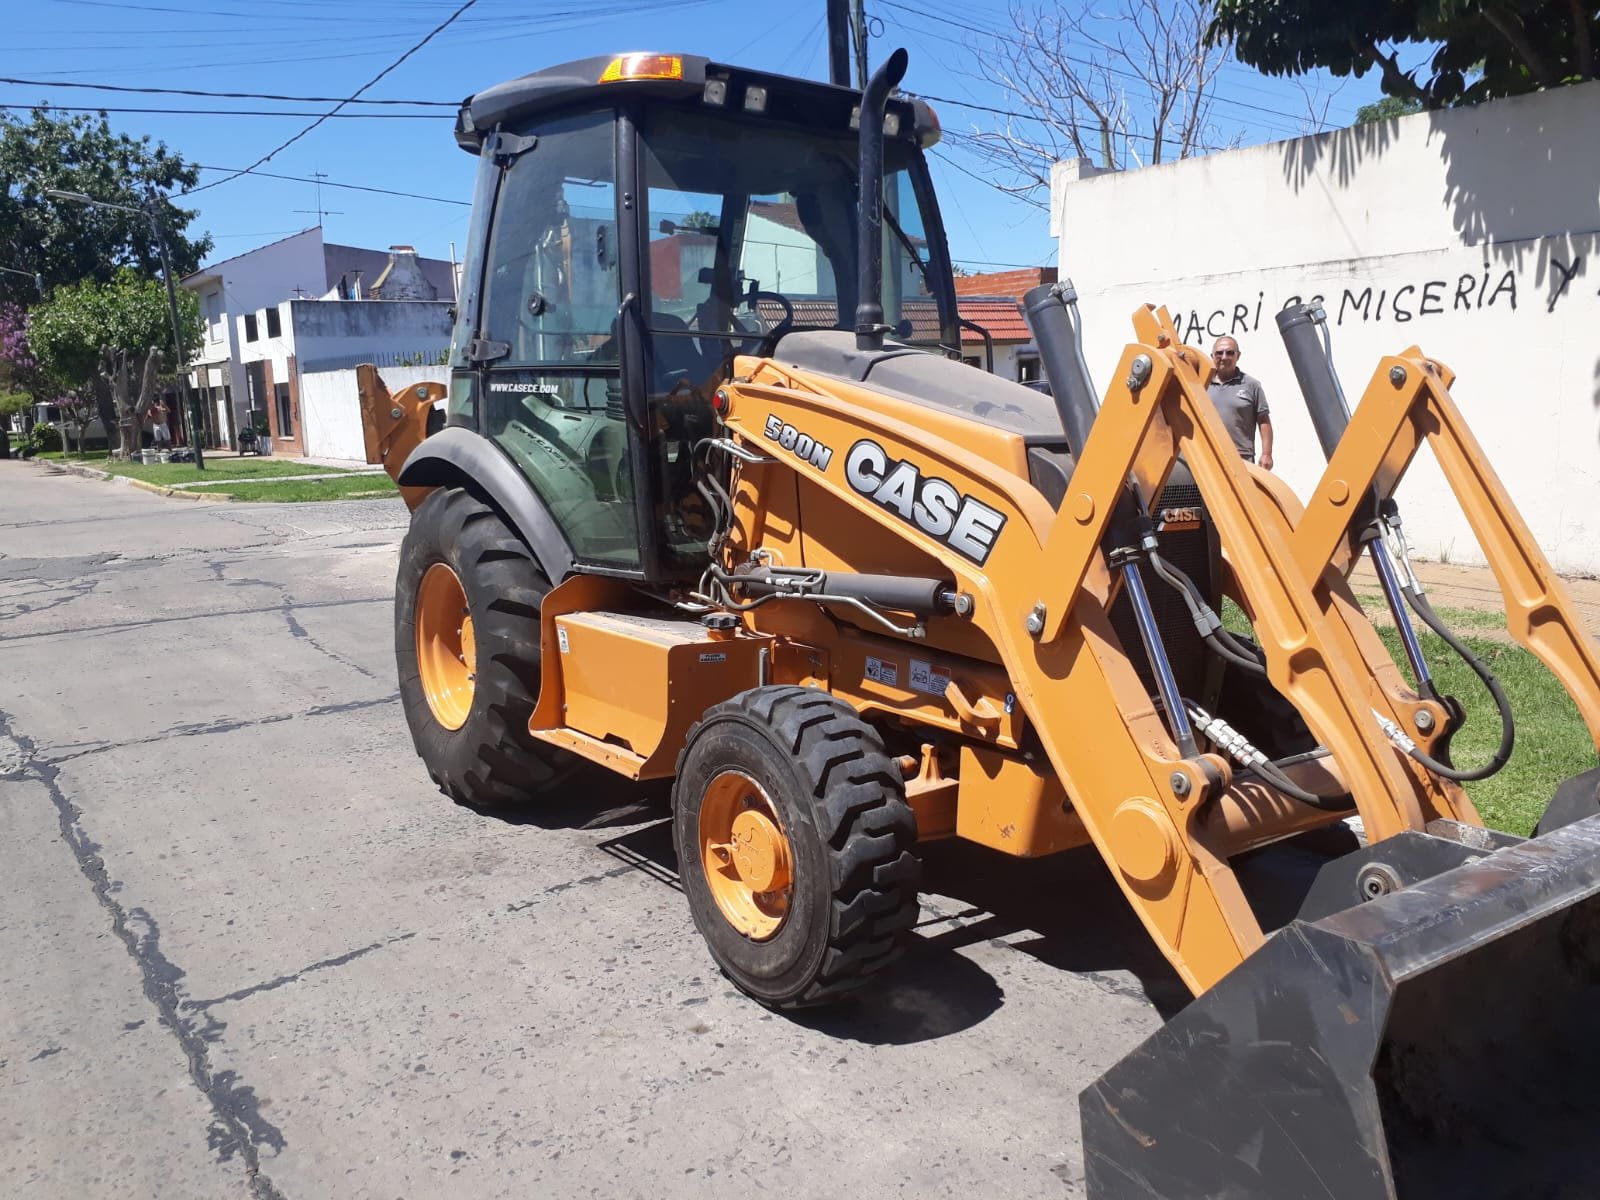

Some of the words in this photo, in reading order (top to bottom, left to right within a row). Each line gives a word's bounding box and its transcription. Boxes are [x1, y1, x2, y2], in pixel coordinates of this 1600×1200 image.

[490, 383, 559, 394] WWW.CASECE.COM
[764, 413, 834, 472] 580N
[845, 439, 1007, 567] CASE
